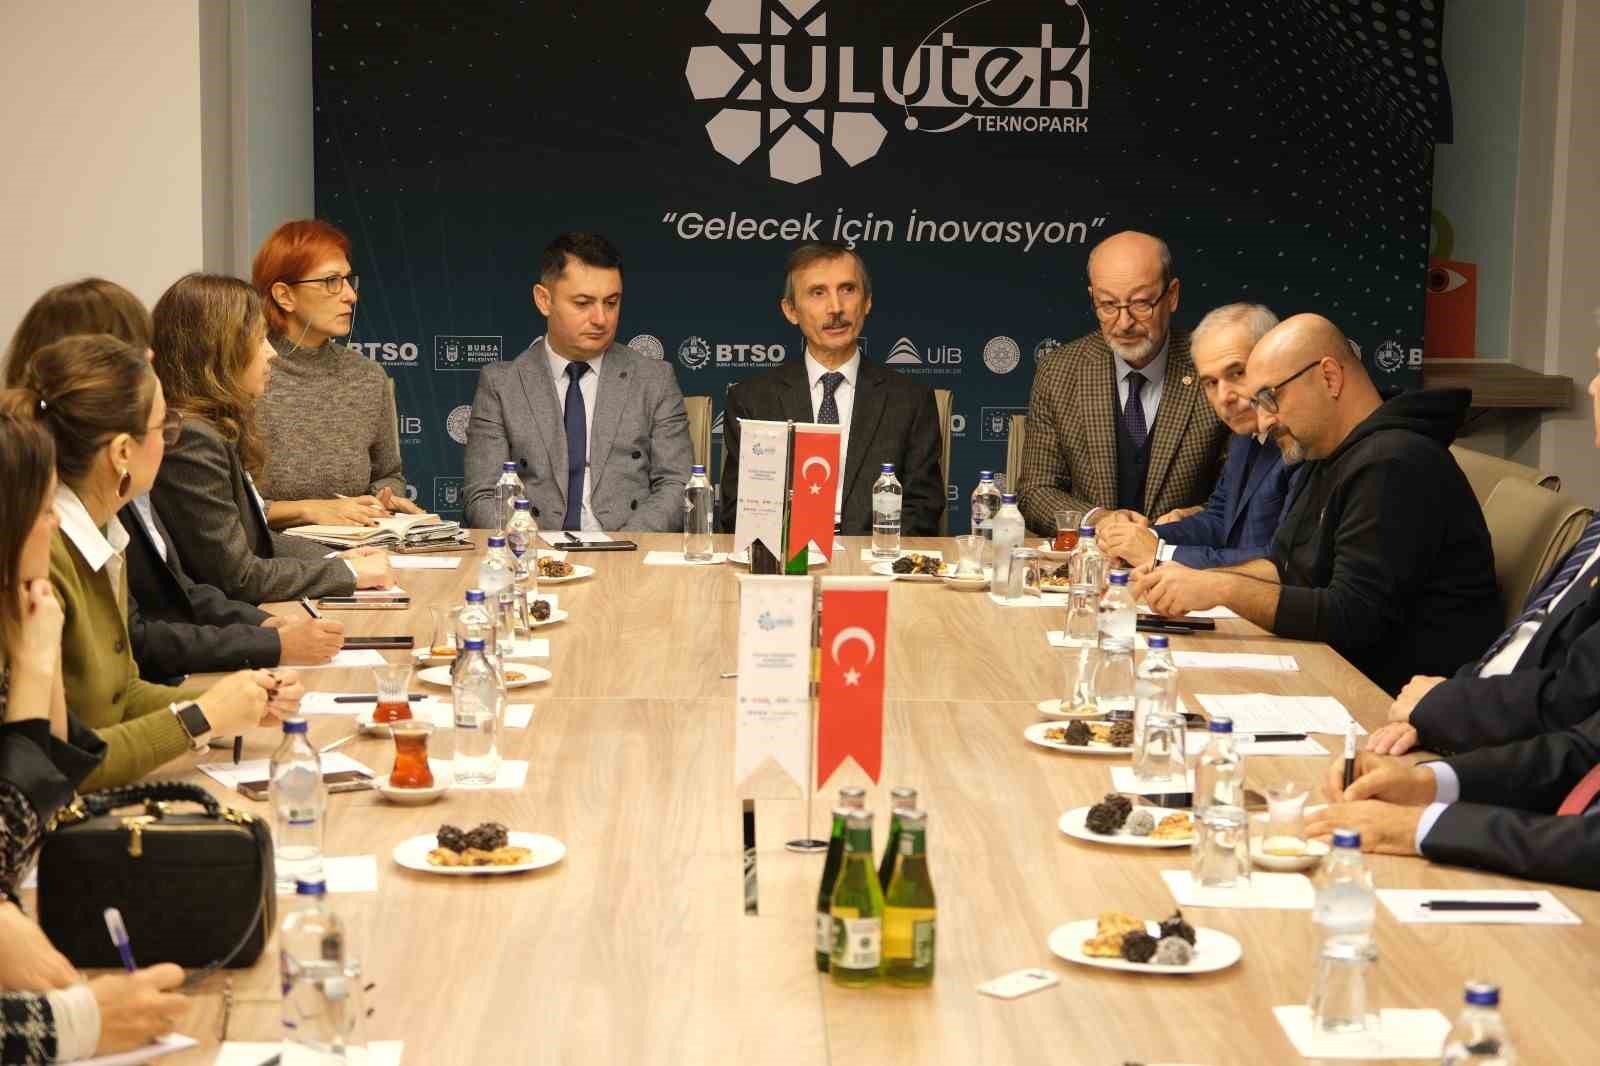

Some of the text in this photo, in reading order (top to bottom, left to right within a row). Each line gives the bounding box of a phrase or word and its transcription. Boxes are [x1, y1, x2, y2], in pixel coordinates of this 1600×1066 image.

[974, 115, 1089, 133] TEKNOPARK
[832, 207, 894, 250] İçin
[467, 344, 498, 352] BURSA
[716, 344, 785, 362] BTSO
[927, 345, 962, 364] UİB
